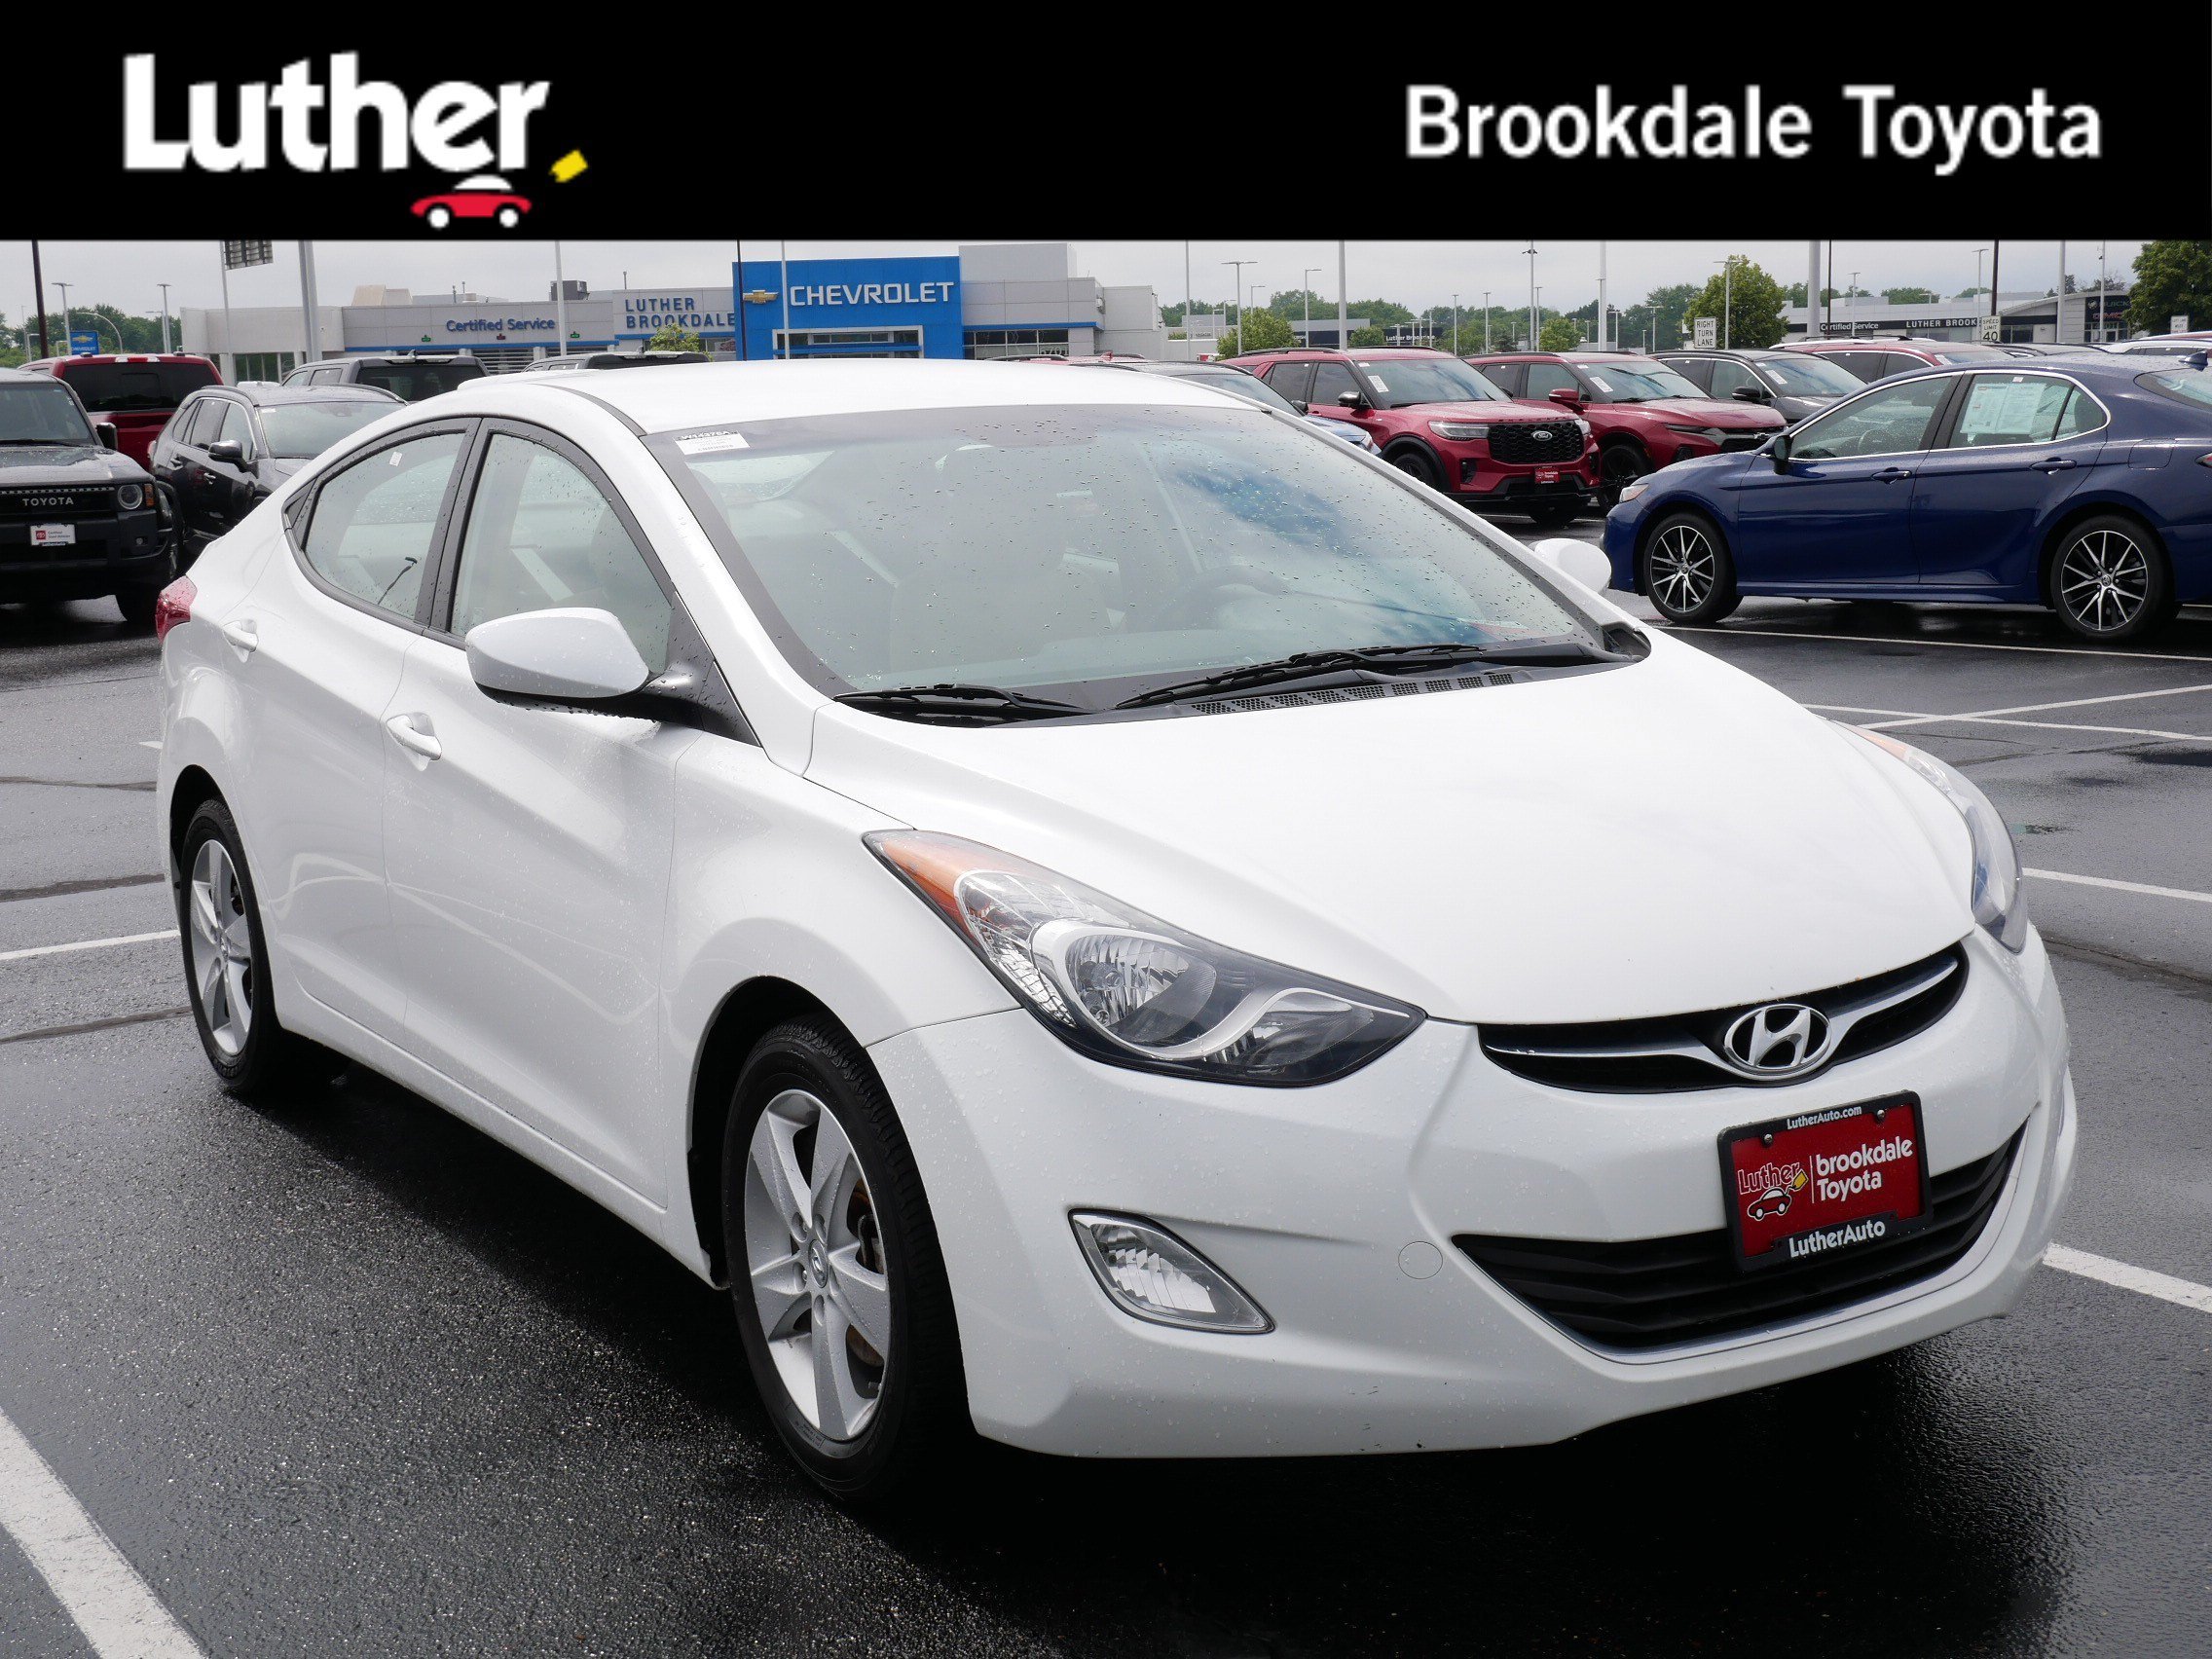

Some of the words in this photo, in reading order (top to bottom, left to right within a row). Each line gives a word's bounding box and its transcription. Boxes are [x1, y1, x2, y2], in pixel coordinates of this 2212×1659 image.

[790, 281, 955, 307] CHEVROLET
[624, 296, 695, 313] LUTHER
[446, 317, 503, 332] Certified
[507, 317, 556, 331] Service
[626, 313, 735, 329] BROOKDALE
[1696, 320, 1714, 329] RIGHT
[1854, 321, 1879, 330] Service
[1905, 319, 1941, 328] LUTHER
[1945, 318, 1978, 327] BROOK
[1697, 338, 1714, 347] LANE
[1982, 331, 1999, 342] 40
[21, 497, 75, 507] TOYOTA
[1787, 1105, 1862, 1130] LutherAuto.com
[1816, 1135, 1914, 1177] brookdale
[1737, 1161, 1801, 1196] Luther
[1817, 1169, 1883, 1203] Toyota
[1788, 1219, 1887, 1259] LutherAuto
